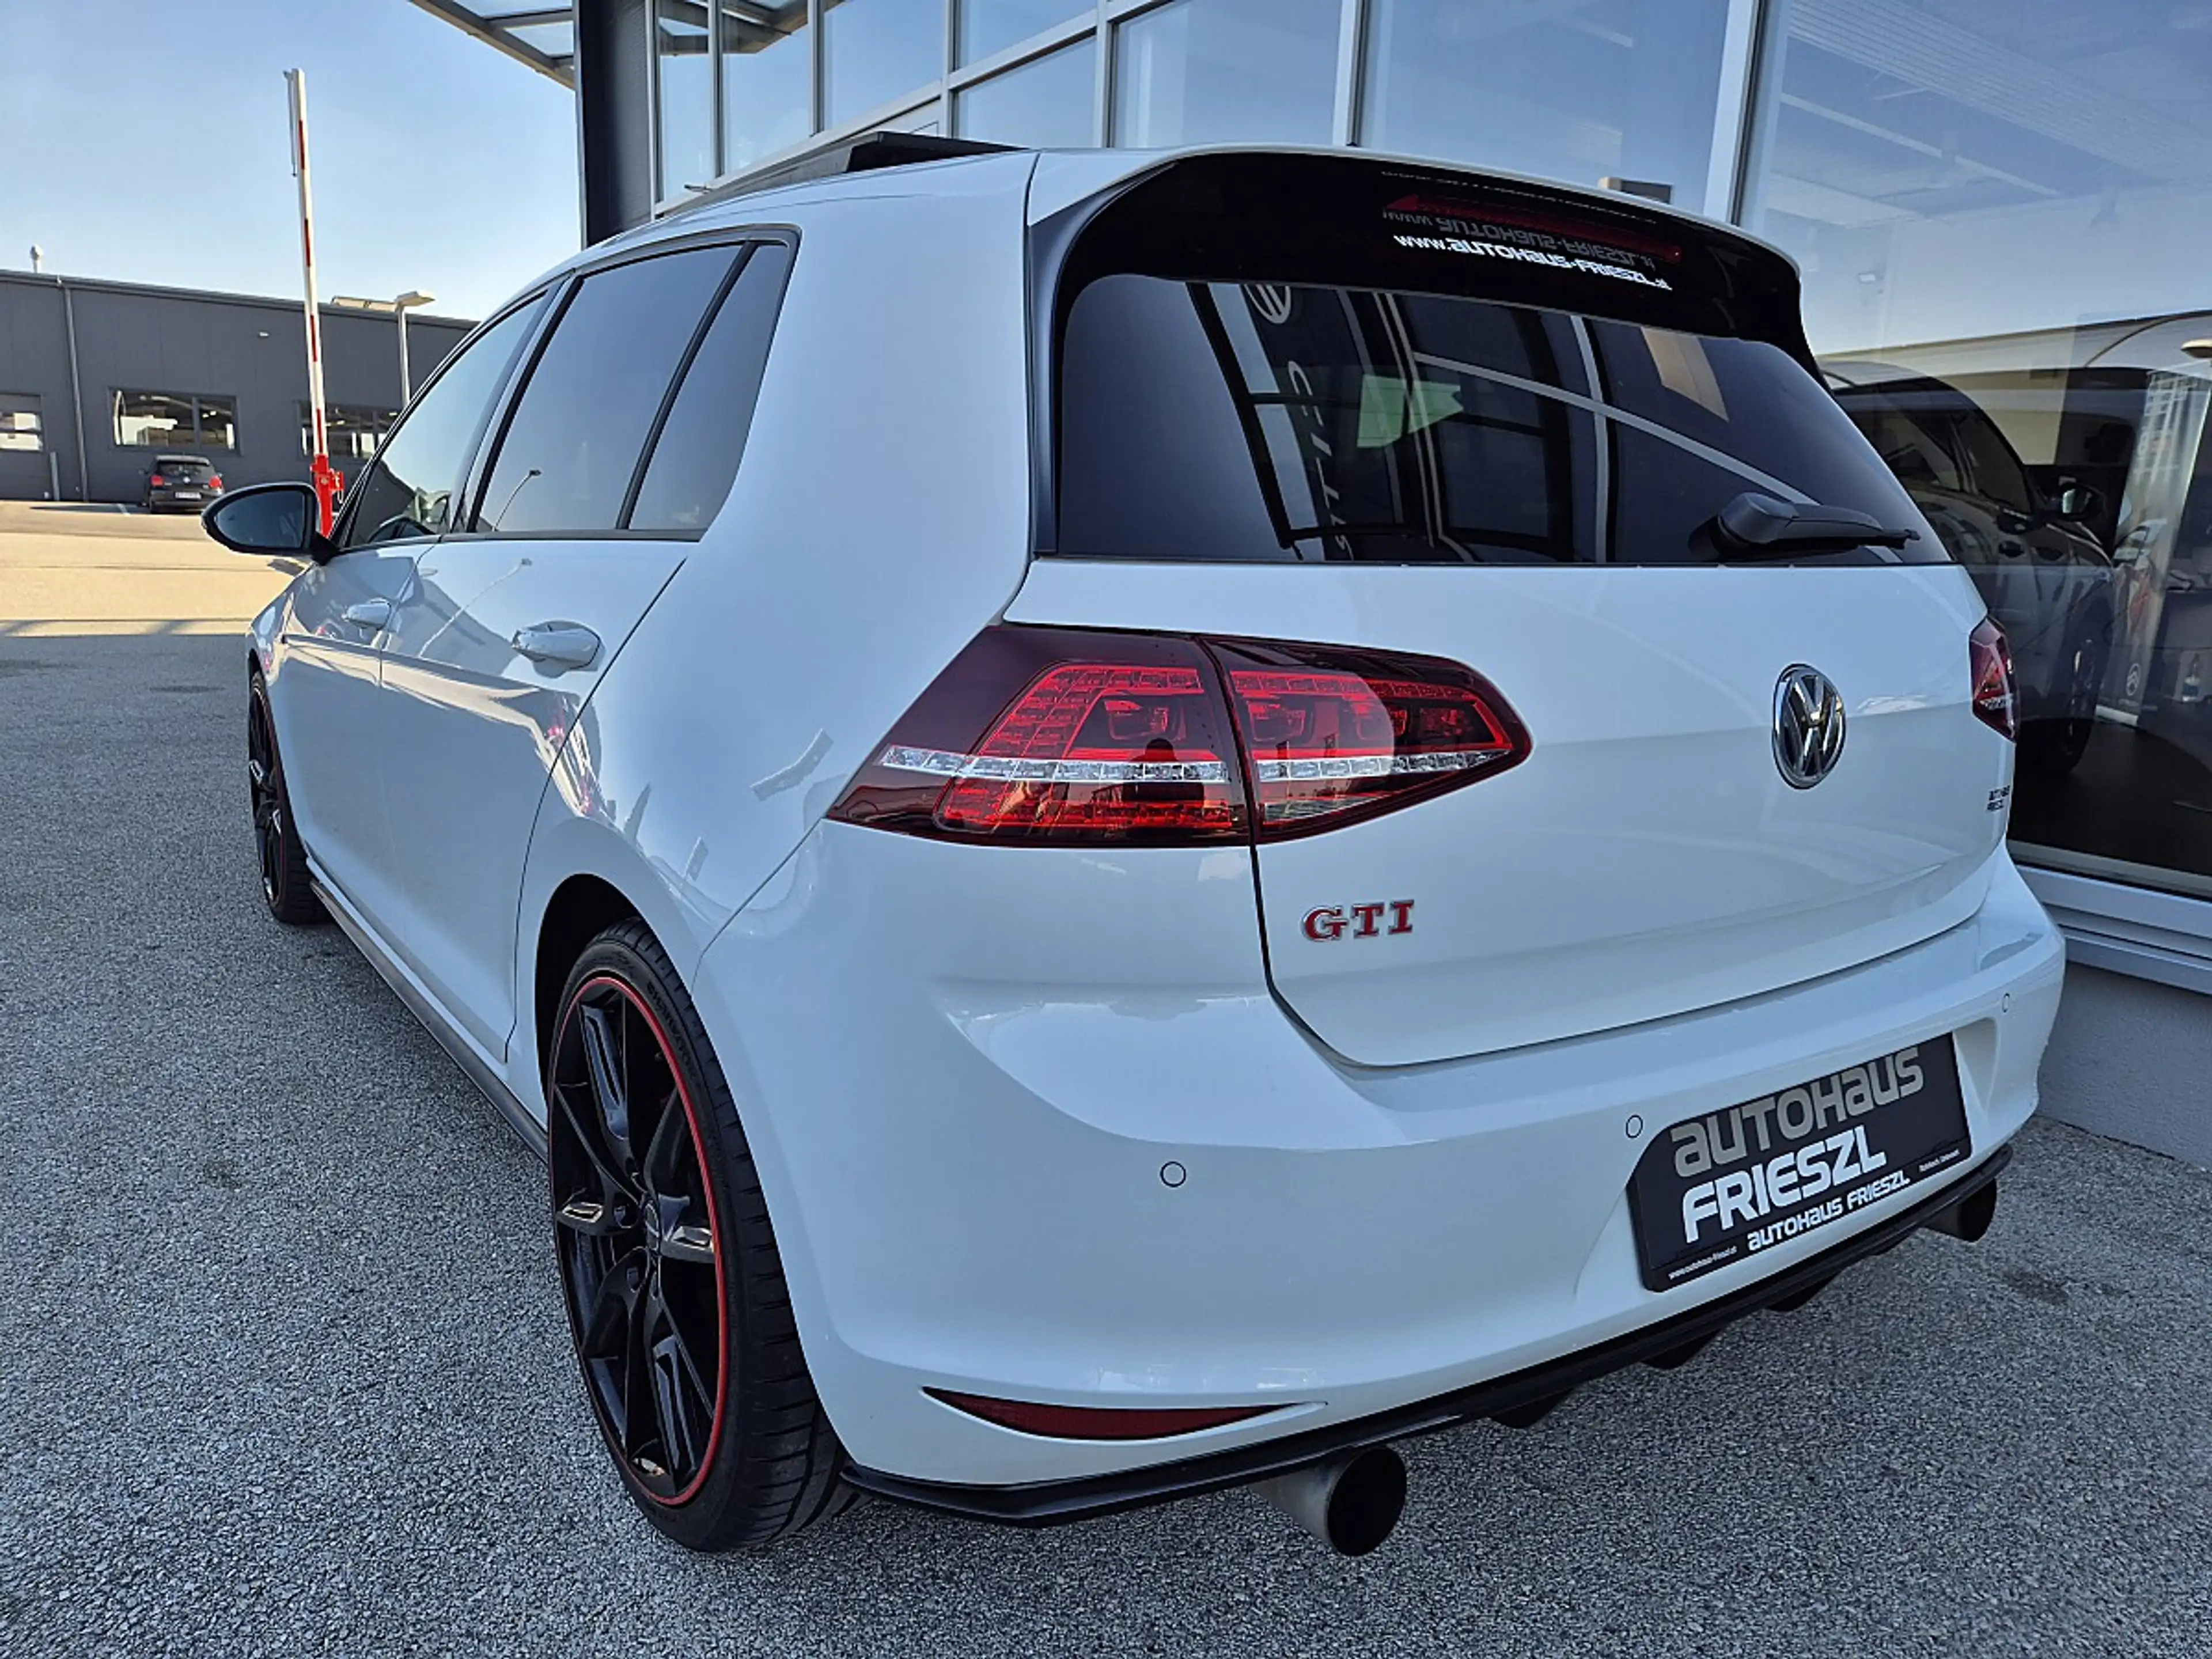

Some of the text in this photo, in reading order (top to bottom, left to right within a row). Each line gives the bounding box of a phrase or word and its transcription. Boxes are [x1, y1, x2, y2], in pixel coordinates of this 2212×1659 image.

[1300, 899, 1415, 942] GTI
[1681, 1124, 1887, 1244] FRIESZL
[1846, 1169, 1911, 1210] FRIESZL
